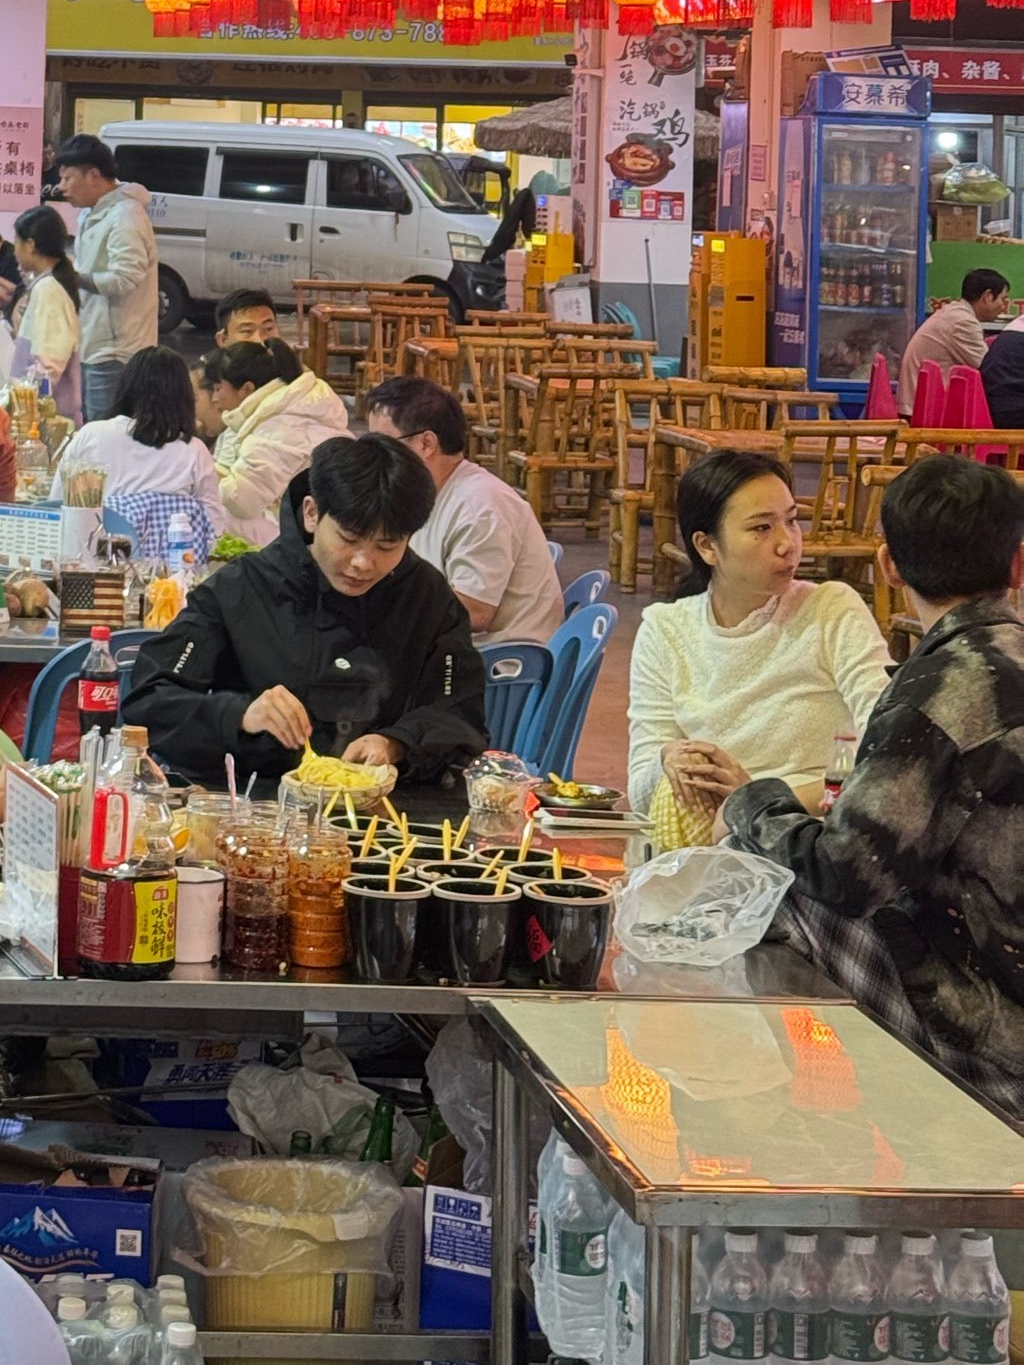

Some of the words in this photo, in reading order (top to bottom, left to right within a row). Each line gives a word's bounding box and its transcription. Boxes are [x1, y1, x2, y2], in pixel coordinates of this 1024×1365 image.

[706, 54, 736, 67] 玉芬
[912, 59, 1024, 81] 肉、杂酱、
[844, 83, 908, 107] 安慕希
